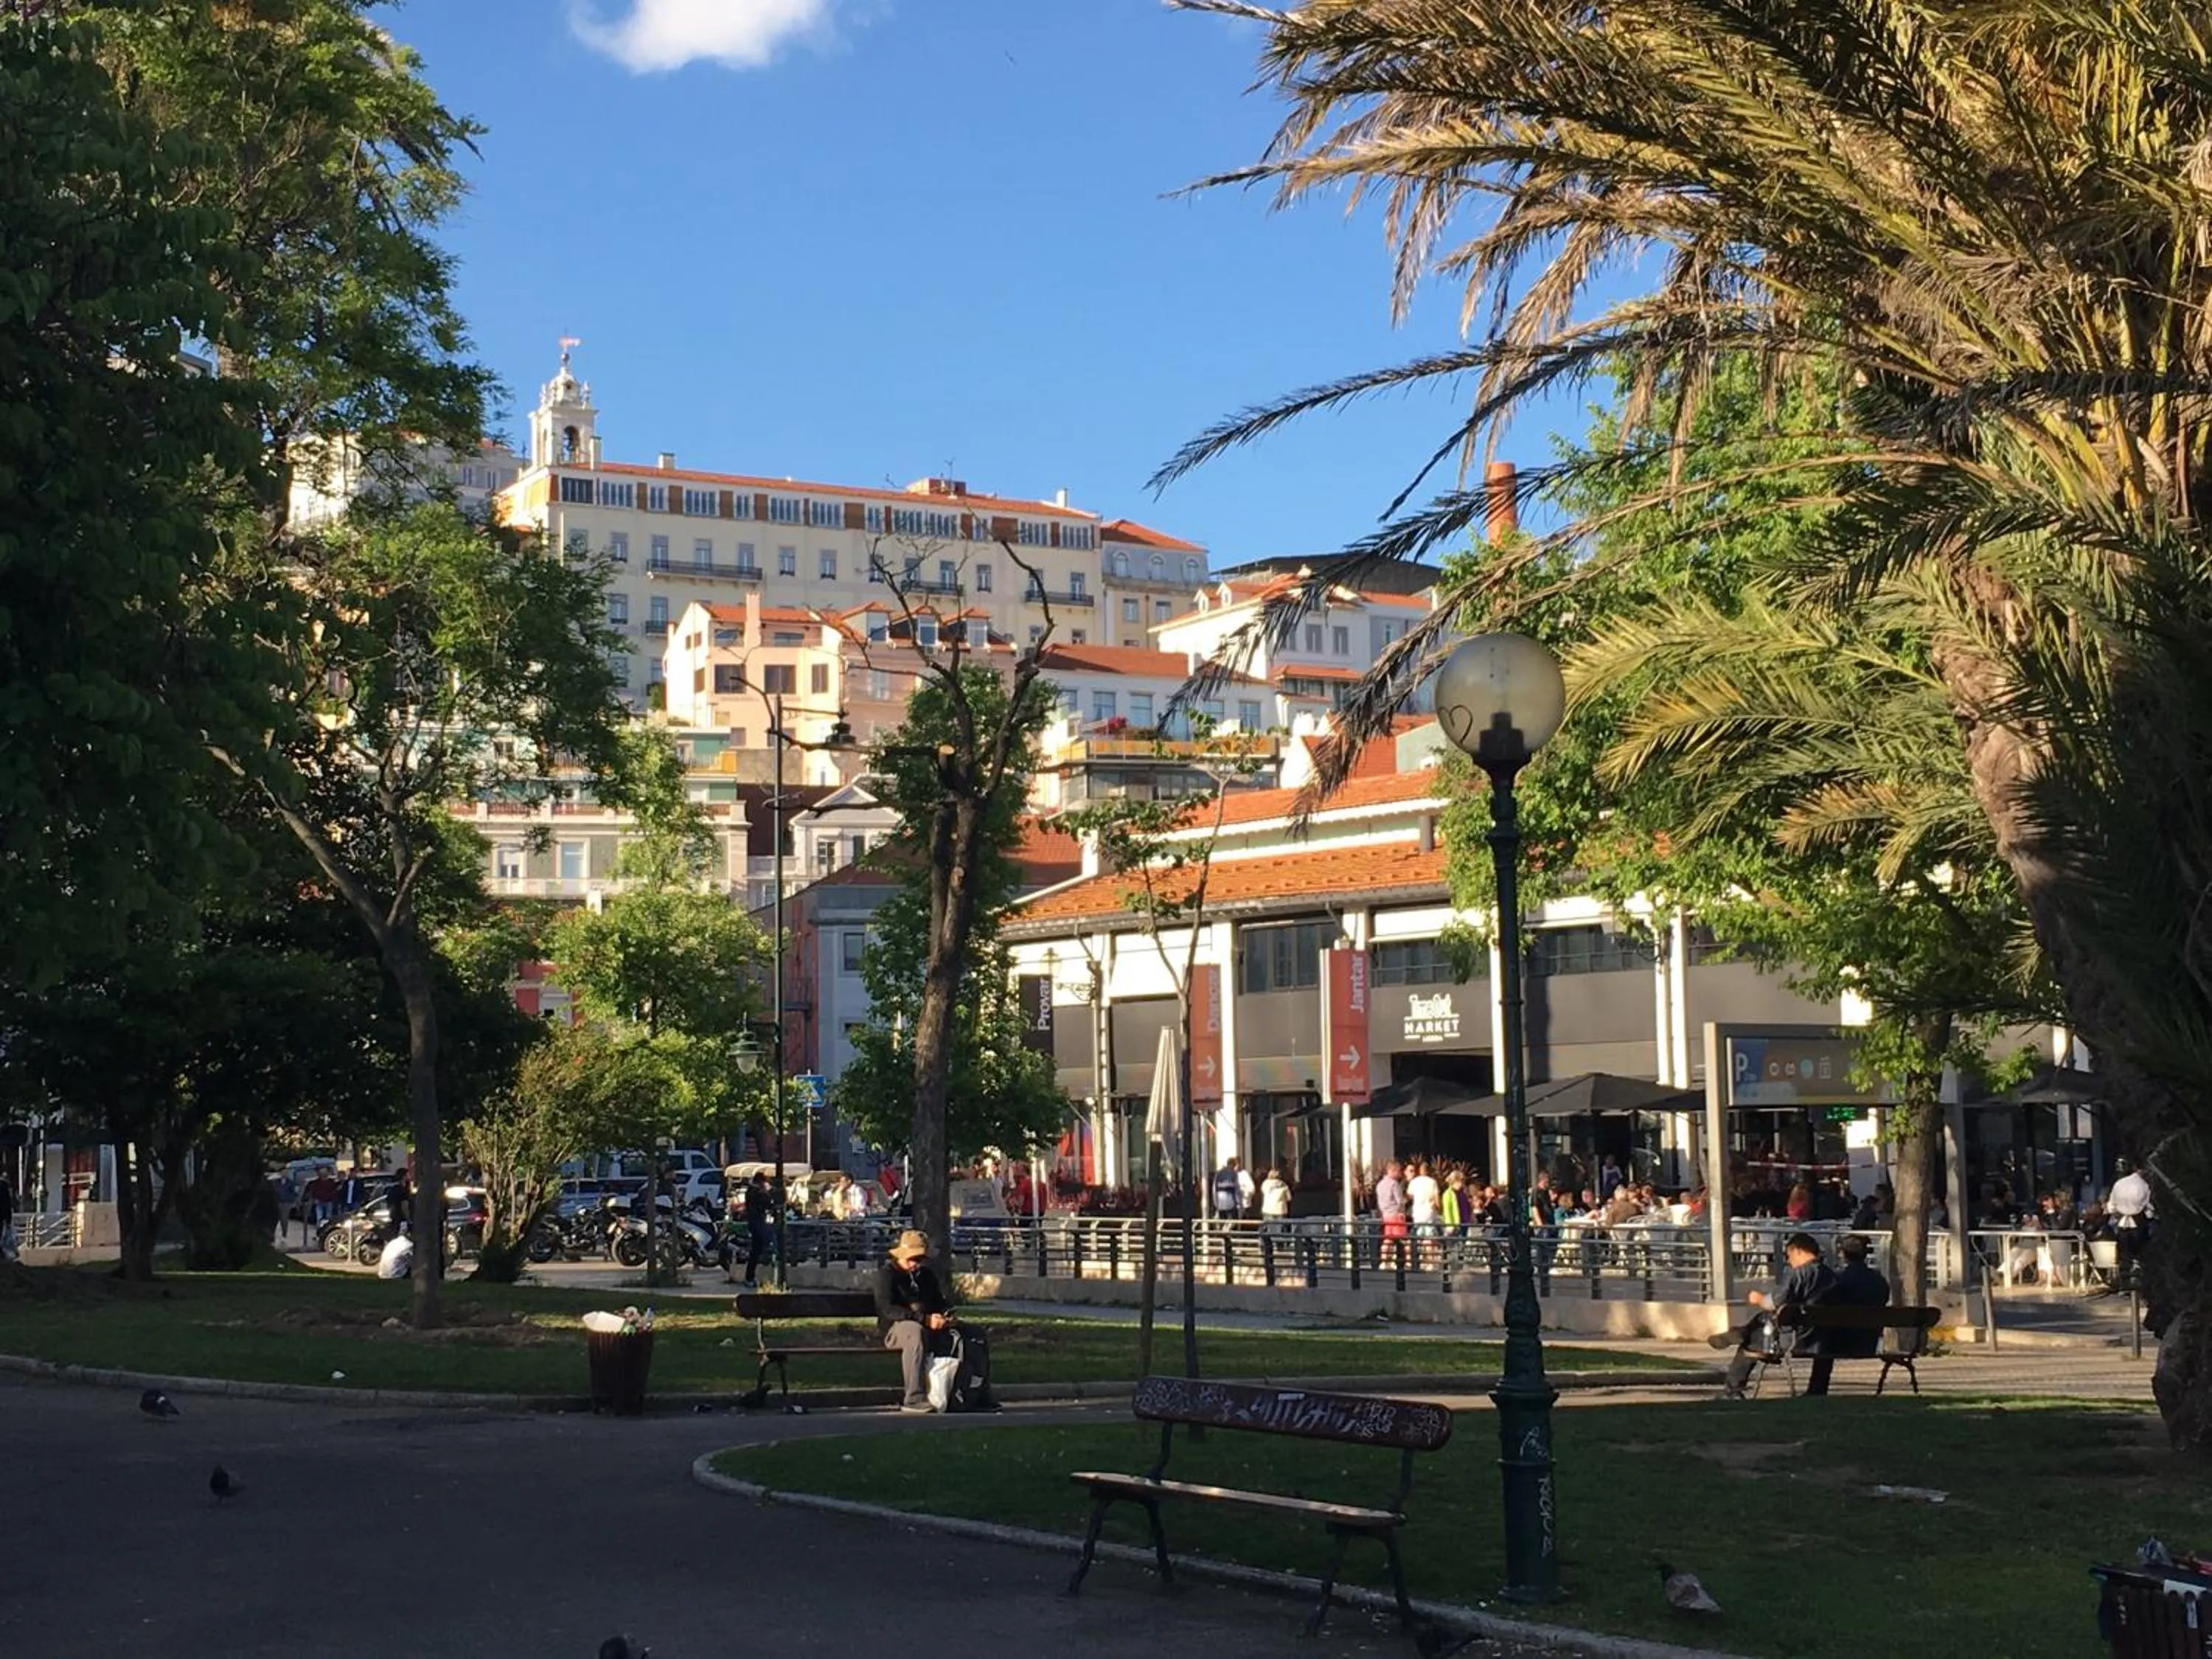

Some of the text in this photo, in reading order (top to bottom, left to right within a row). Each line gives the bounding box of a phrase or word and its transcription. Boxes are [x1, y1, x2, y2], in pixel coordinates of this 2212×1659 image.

[1037, 977, 1051, 1030] Provar
[1350, 953, 1364, 1014] Jantar
[1404, 1019, 1459, 1034] MARKET
